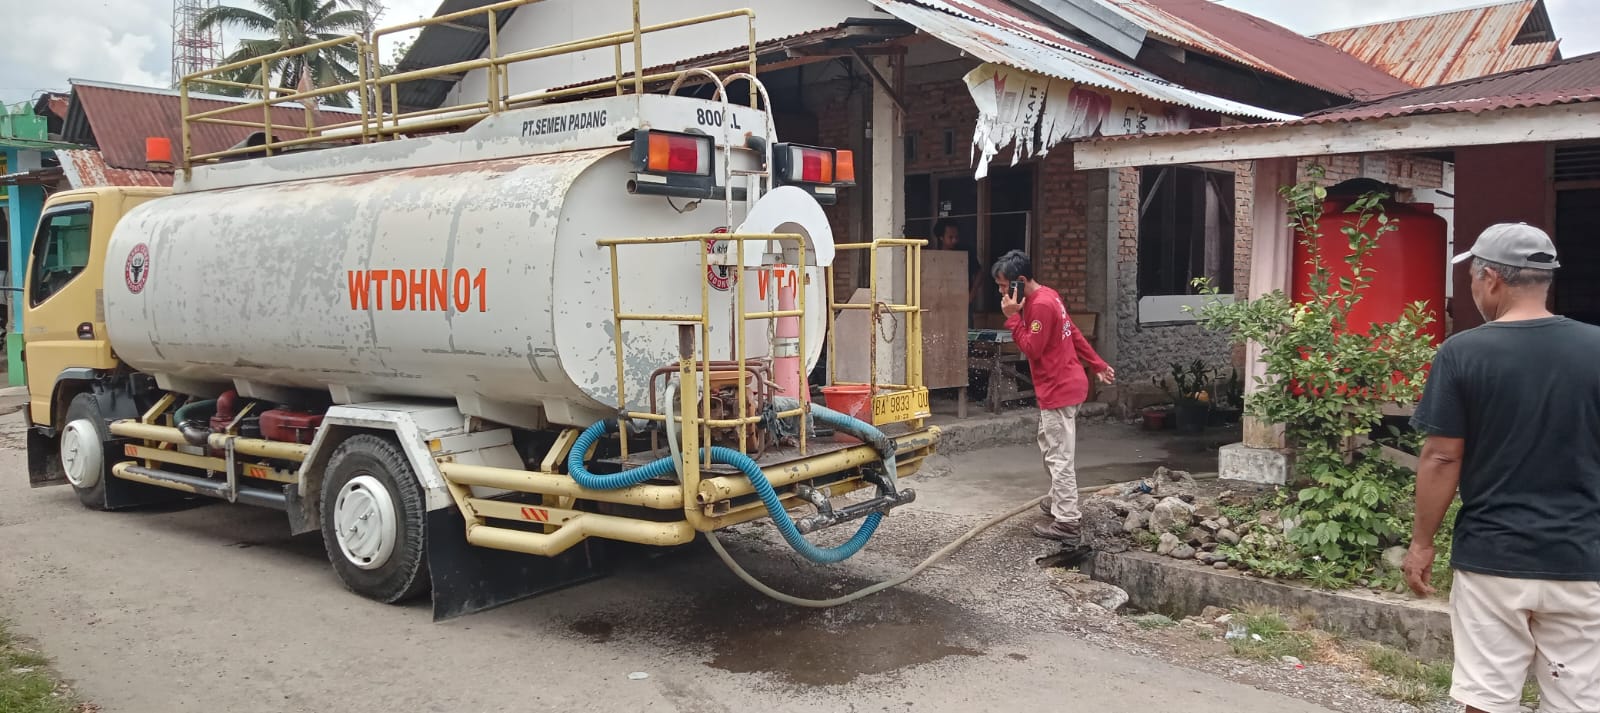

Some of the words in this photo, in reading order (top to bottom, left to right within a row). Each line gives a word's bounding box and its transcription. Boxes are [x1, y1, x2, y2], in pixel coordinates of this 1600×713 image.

[568, 109, 607, 131] PADANG
[696, 107, 741, 129] 800.L
[875, 399, 886, 416] BA
[890, 395, 910, 413] 9833
